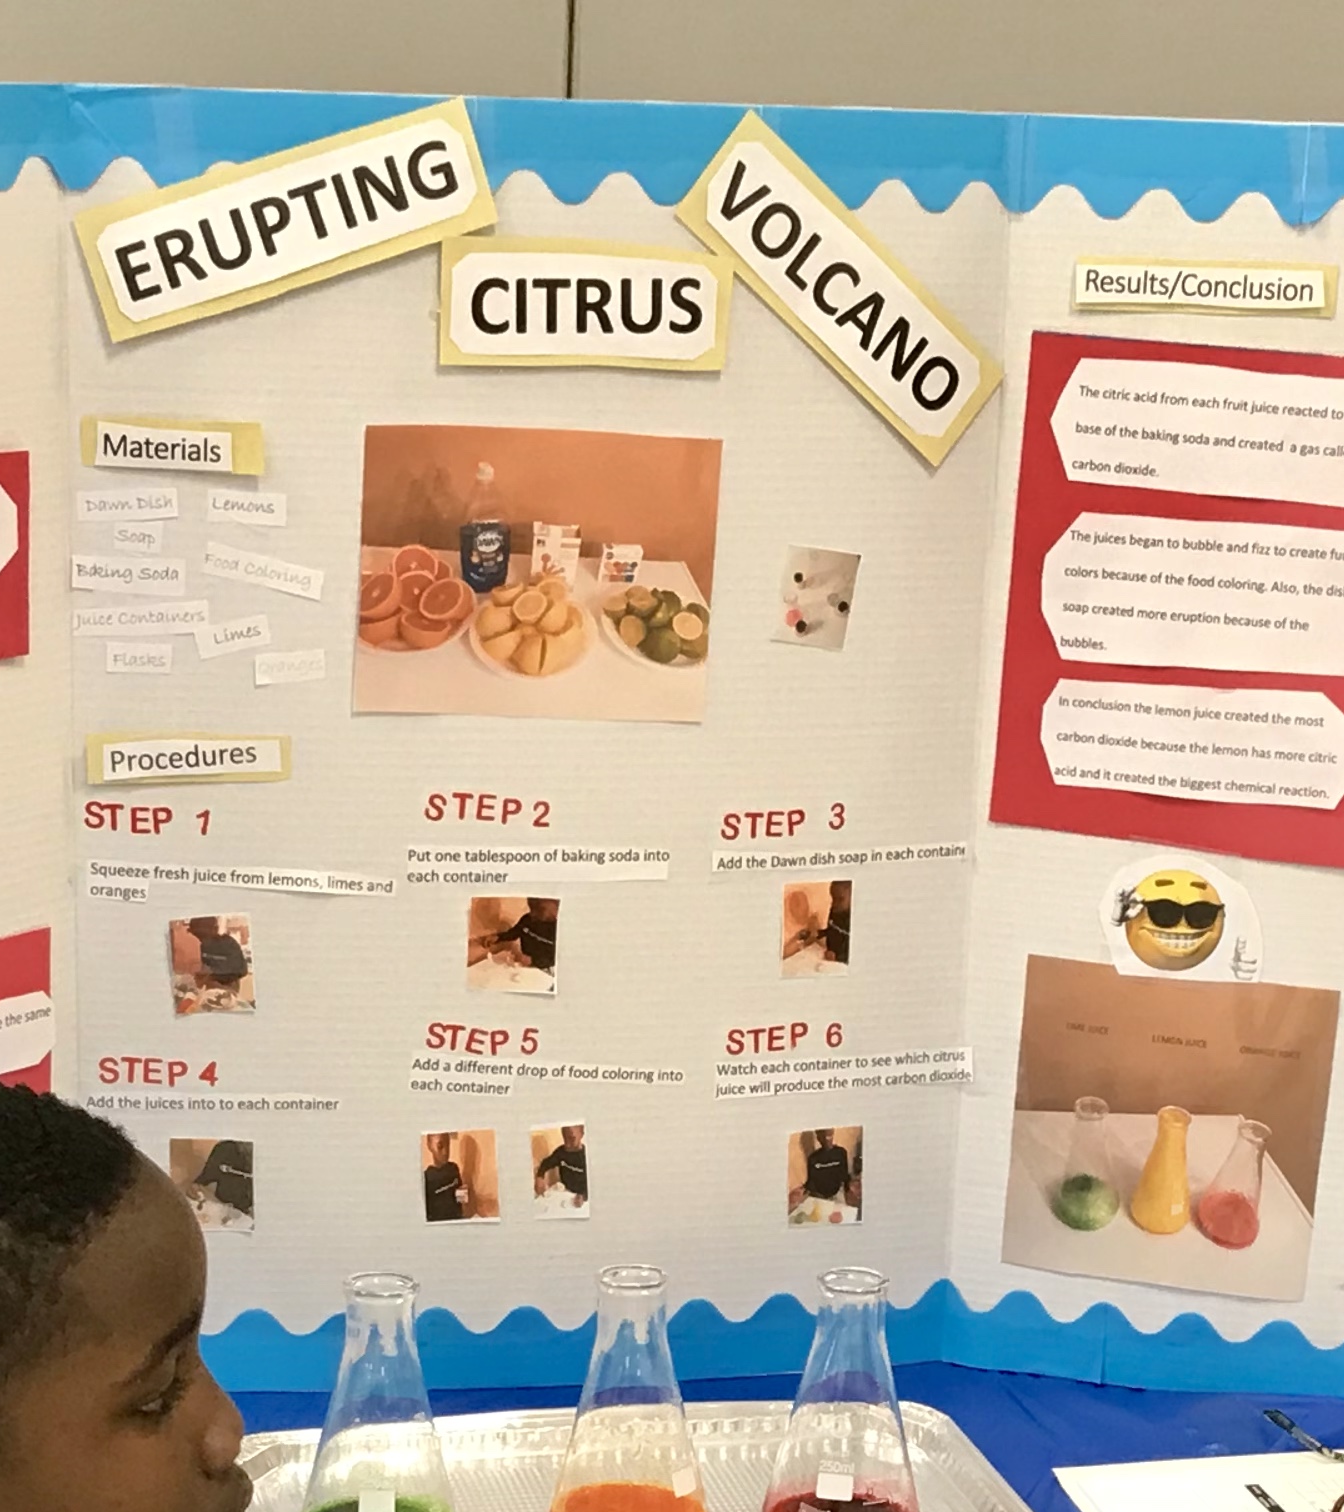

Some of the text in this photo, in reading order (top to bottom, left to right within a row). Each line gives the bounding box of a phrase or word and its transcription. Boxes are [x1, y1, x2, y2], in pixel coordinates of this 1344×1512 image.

[113, 139, 458, 303] ERUPTING
[718, 161, 960, 411] VOLCANO
[1085, 269, 1314, 302] Results/Conclusion
[470, 277, 703, 335] CITRUS
[1079, 385, 1099, 399] The
[1102, 387, 1131, 402] citric
[1134, 390, 1157, 404] acid
[1160, 391, 1189, 407] from
[1192, 396, 1220, 409] each
[1223, 397, 1248, 413] fruit
[1250, 400, 1279, 416] juice
[1282, 405, 1328, 419] reacted
[1331, 408, 1343, 421] to
[103, 433, 221, 462] Materials
[1076, 423, 1101, 436] base
[1104, 424, 1117, 438] of
[1119, 426, 1139, 439] the
[1141, 427, 1180, 446] baking
[1182, 432, 1210, 446] soda
[1213, 435, 1236, 448] and
[1238, 436, 1284, 452] created
[1289, 444, 1297, 454] a
[1300, 444, 1320, 458] gas
[1072, 459, 1159, 477] carbon dioxide.
[86, 495, 173, 512] Dawn Dish
[212, 497, 275, 514] Lemons
[115, 529, 156, 547] Soap
[76, 563, 179, 583] Baking Soda
[205, 552, 311, 592] Food Coloring
[74, 608, 205, 630] Juice Containers
[213, 624, 261, 644] Limes
[113, 653, 166, 667] Flasks
[1059, 696, 1324, 728] In conclusion the lemon juice created the most
[110, 744, 257, 773] Procedures
[1057, 731, 1337, 764] carbon dioxide because the lemon has more citric
[84, 801, 211, 835] STEP 1
[424, 792, 550, 827] STEP 2
[721, 803, 845, 840] STEP 3
[408, 849, 670, 865] Put one tablespoon of baking soda into
[717, 856, 742, 870] Add
[746, 856, 767, 868] the
[771, 855, 806, 868] Dawn
[810, 852, 835, 865] dish
[838, 852, 868, 865] soap
[871, 846, 882, 861] in
[886, 847, 914, 861] each
[90, 862, 393, 893] Squeeze fresh juice from lemons, limes and
[407, 871, 508, 883] each container
[90, 884, 146, 901] oranges
[5, 1013, 22, 1027] the
[25, 1007, 51, 1023] same
[426, 1023, 539, 1055] STEP 5
[726, 1022, 842, 1054] STEP 6
[98, 1057, 219, 1087] STEP 4
[716, 1050, 965, 1076] Watch each container to see which citrus
[716, 1068, 971, 1098] juice will produce the most carbon dioxide
[820, 1460, 855, 1473] 250ml
